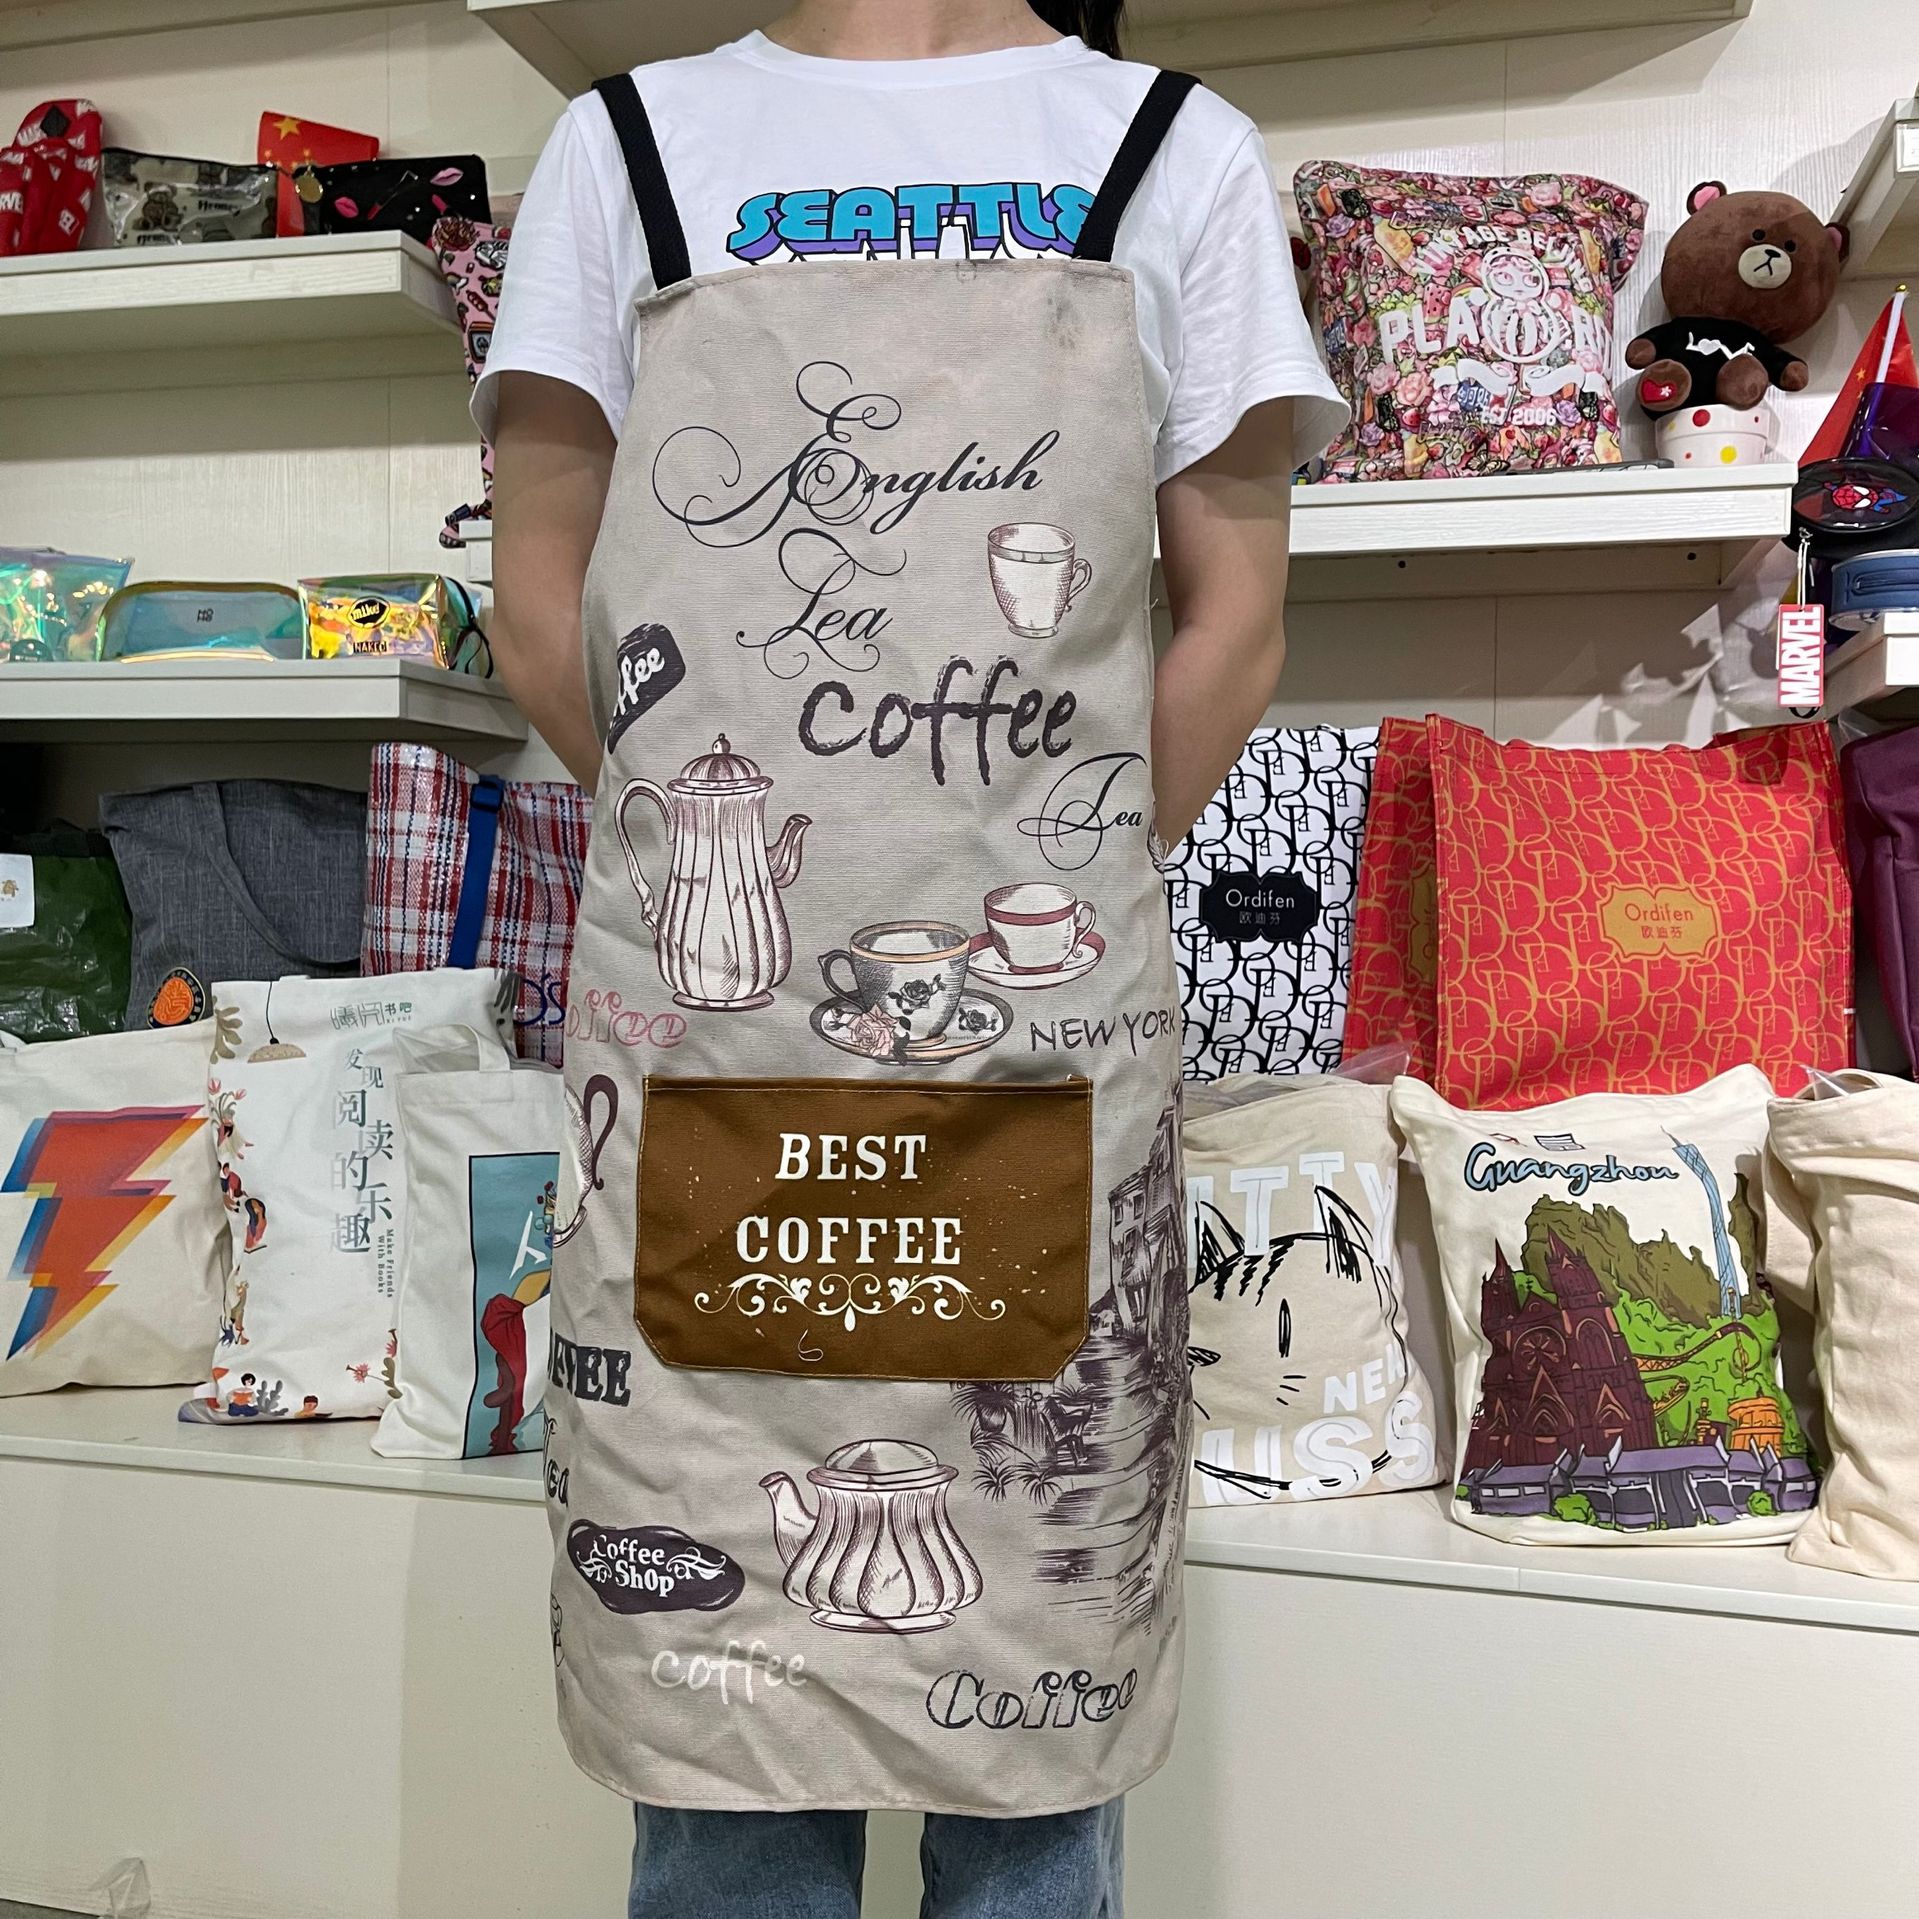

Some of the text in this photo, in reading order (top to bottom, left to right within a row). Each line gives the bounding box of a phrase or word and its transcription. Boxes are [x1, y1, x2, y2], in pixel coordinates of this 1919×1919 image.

[1512, 407, 1558, 425] 2006
[653, 361, 1060, 547] English
[1780, 606, 1820, 705] MARVEL
[1226, 889, 1295, 908] Ordifen
[1625, 903, 1694, 921] Ordifen
[1030, 1005, 1176, 1056] NEW YORK
[775, 1132, 927, 1181] BEST
[1464, 1142, 1680, 1196] Guangzhou
[1186, 1151, 1397, 1271] ITTY
[735, 1215, 962, 1265] COFFEE
[590, 1534, 666, 1566] Coffee
[926, 1668, 1138, 1730] Coffee
